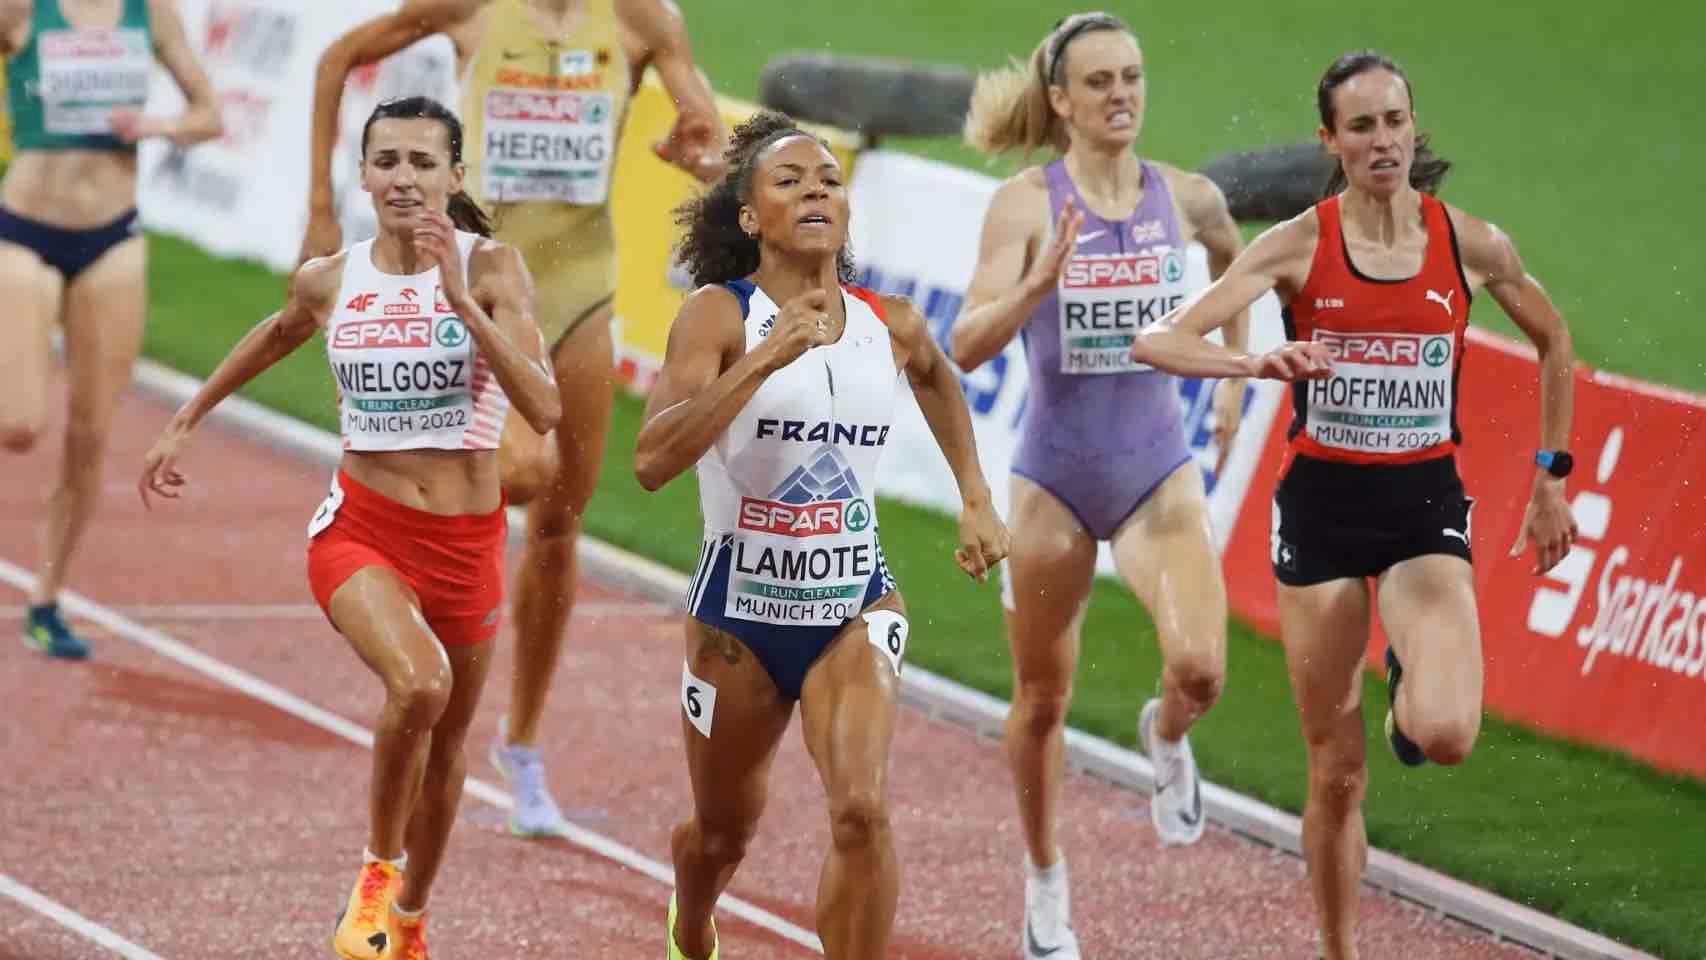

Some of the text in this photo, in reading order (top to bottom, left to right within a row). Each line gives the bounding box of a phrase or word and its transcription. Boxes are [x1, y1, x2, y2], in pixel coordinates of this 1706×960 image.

[488, 92, 581, 121] SPAR
[487, 132, 604, 161] HERING
[1066, 259, 1158, 287] SPAR
[346, 293, 379, 312] 4F
[335, 320, 430, 347] SPAR
[1069, 351, 1134, 368] MUNIC
[1319, 335, 1418, 364] SPAR
[334, 360, 466, 392] WIELGOSZ
[367, 401, 393, 411] RUN
[398, 399, 436, 410] CLEAN
[1313, 376, 1445, 409] HOFFMANN
[349, 410, 466, 432] MUNICH 2022
[1348, 415, 1374, 425] RUN
[1378, 416, 1415, 427] CLEAN
[1315, 425, 1390, 448] MUNICH
[743, 501, 840, 532] SPAR
[736, 541, 871, 581] LAMOTE
[769, 587, 799, 599] RUN
[802, 587, 842, 600] CLEAN
[735, 596, 814, 620] MUNICH
[888, 621, 903, 655] 6
[686, 686, 702, 718] 6
